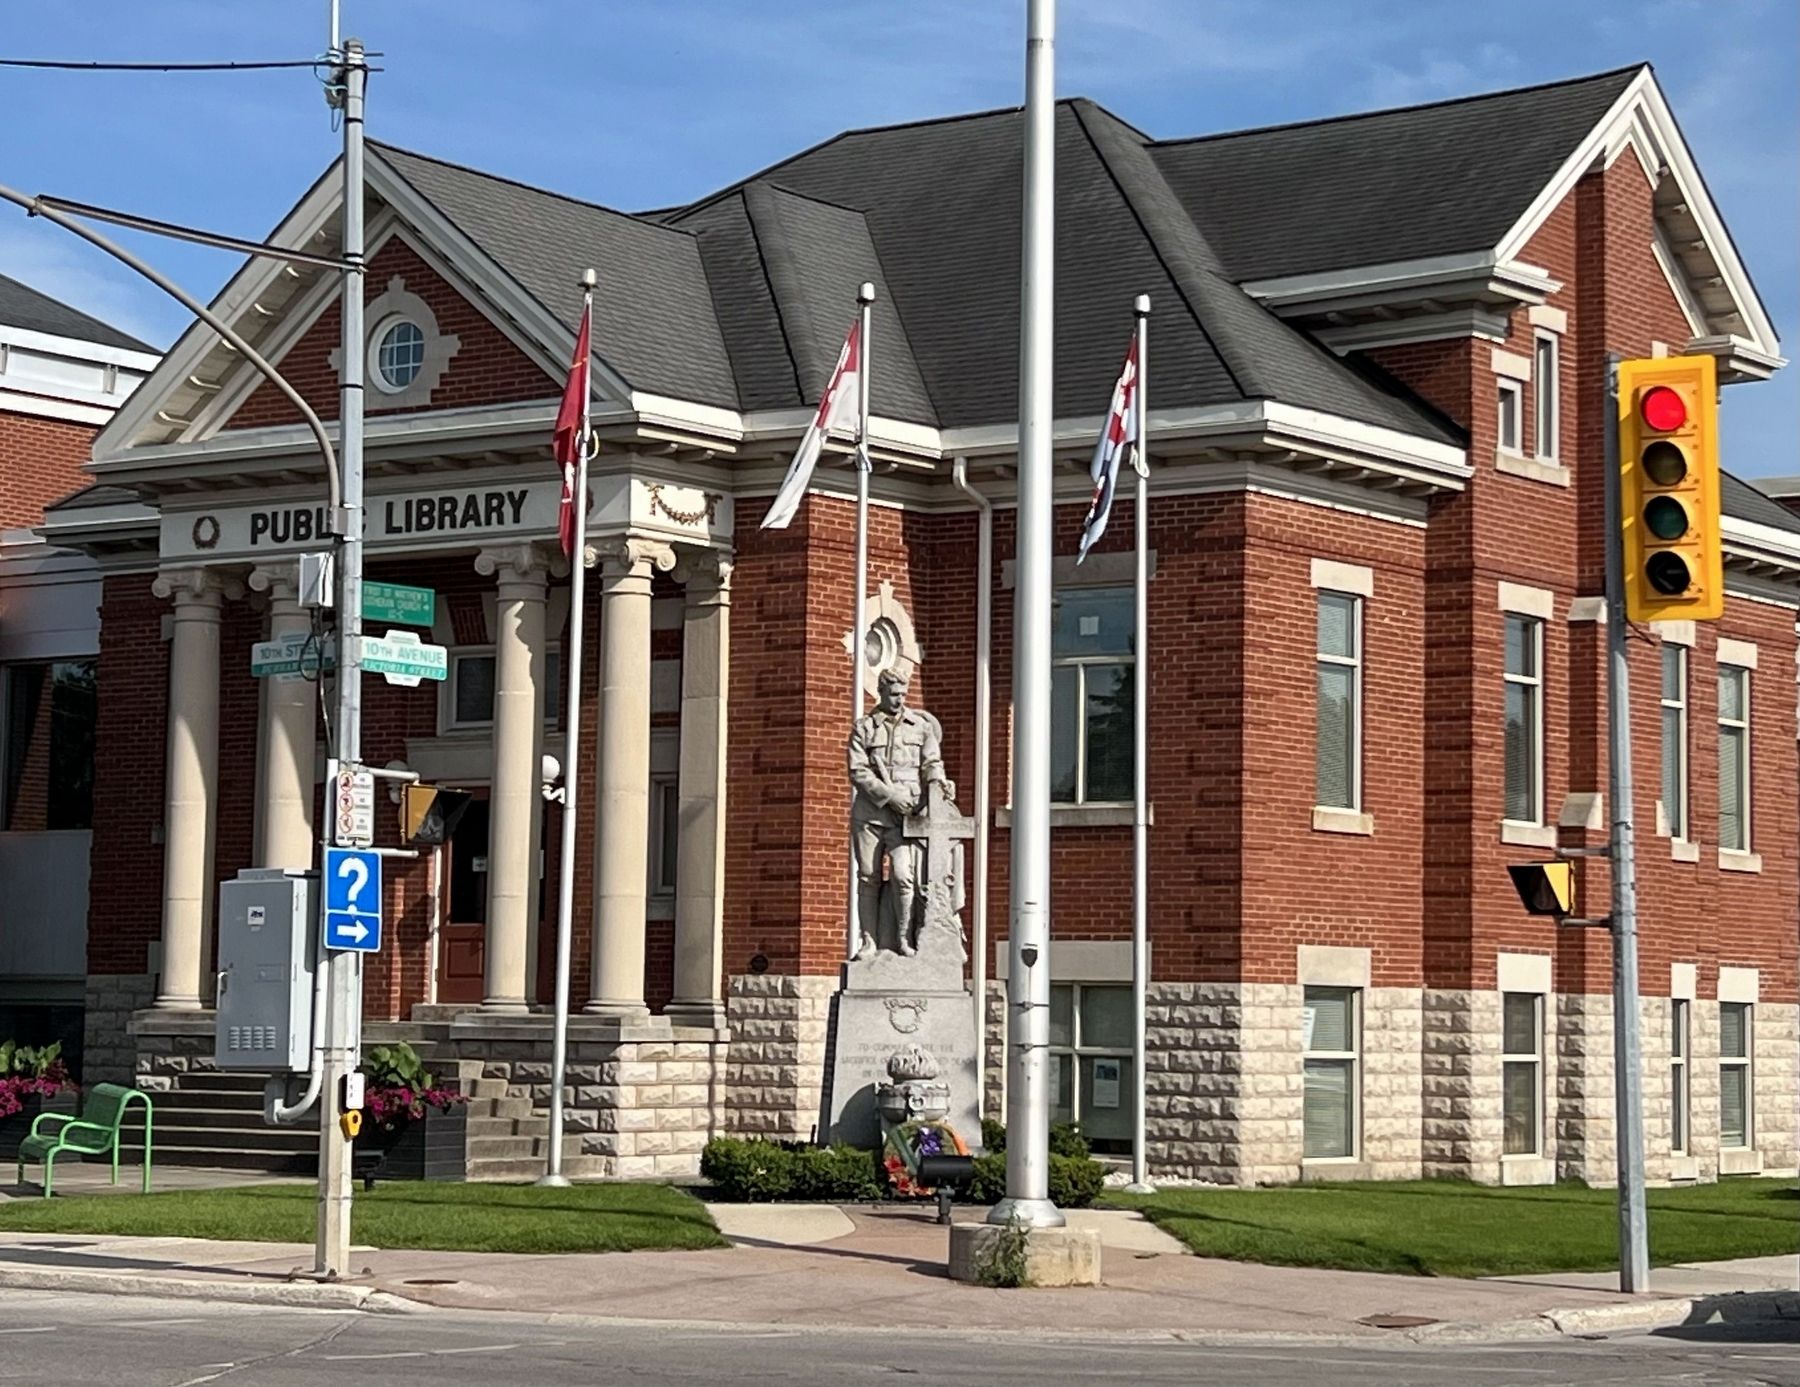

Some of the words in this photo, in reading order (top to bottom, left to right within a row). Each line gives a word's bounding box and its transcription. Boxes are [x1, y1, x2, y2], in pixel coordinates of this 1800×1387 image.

[250, 504, 366, 545] PUBL
[385, 490, 529, 534] LIBRARY
[260, 646, 282, 659] 10TH
[365, 642, 393, 657] 10TH
[397, 647, 443, 664] AVENUE
[338, 857, 369, 914] ?
